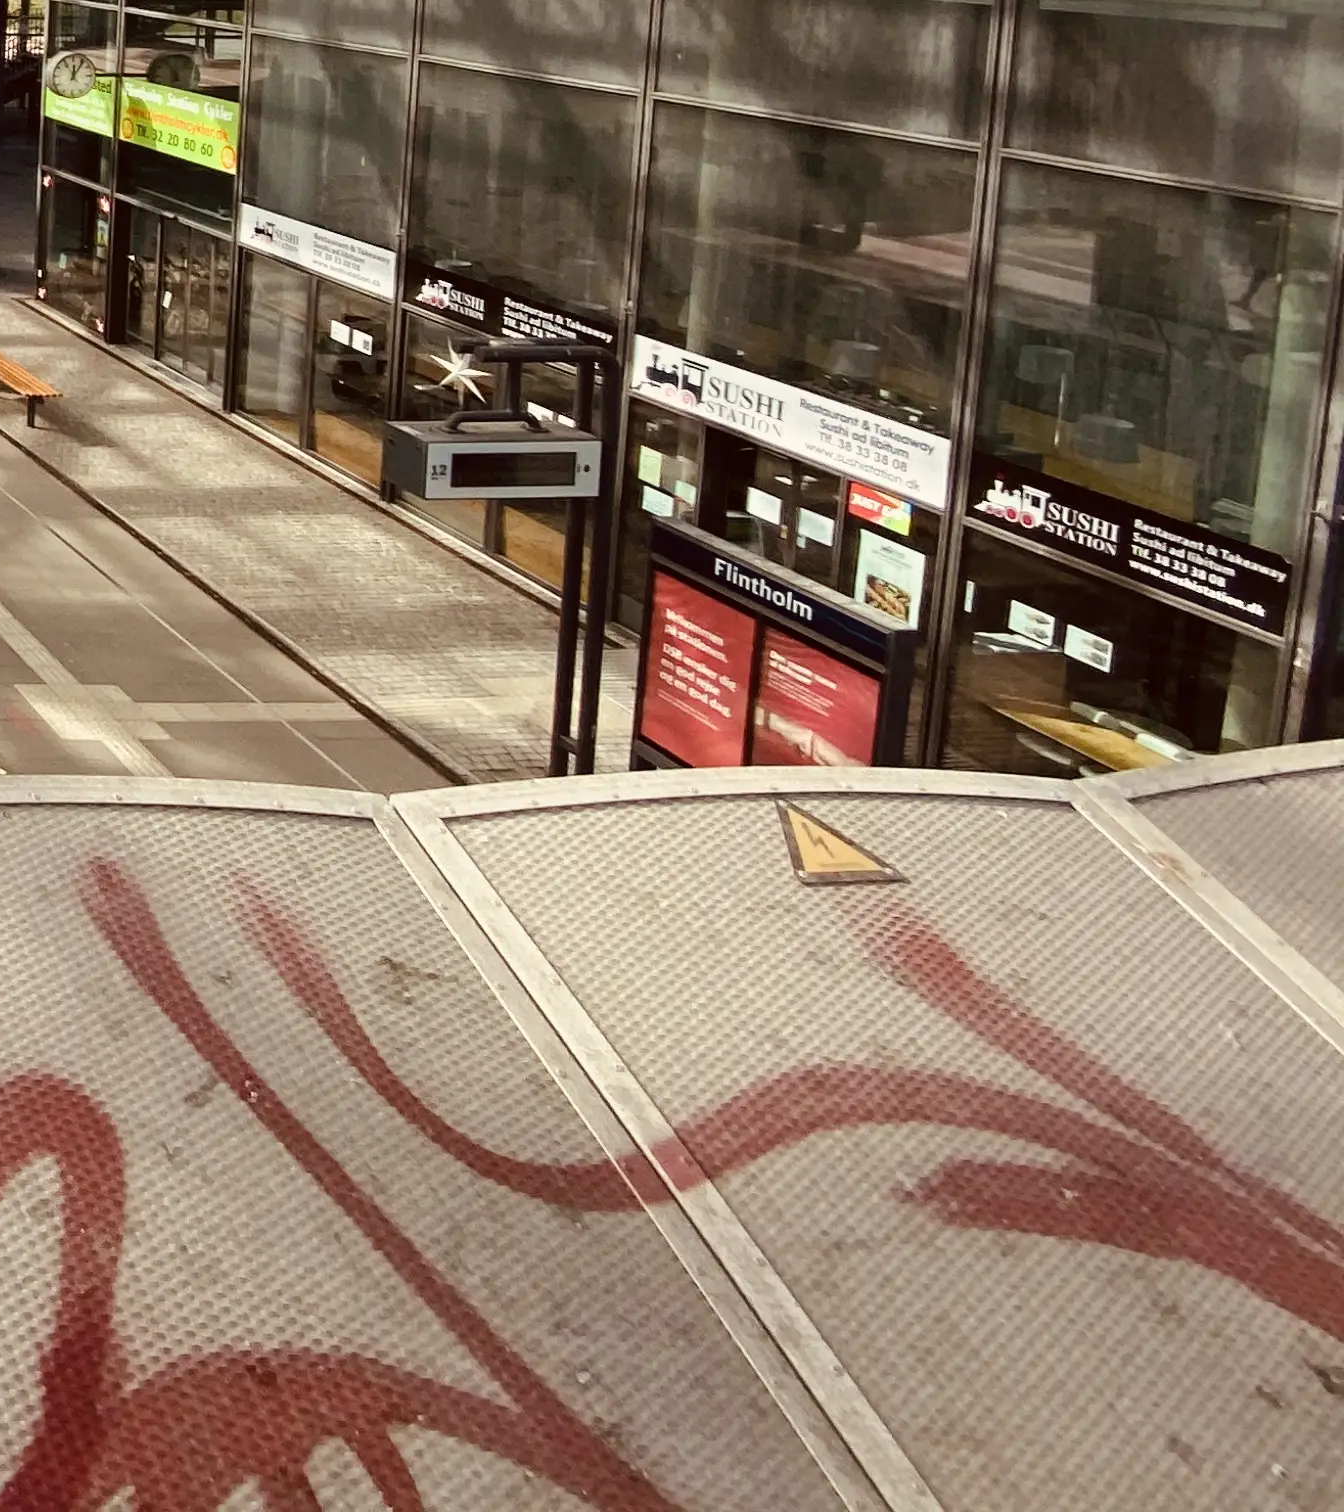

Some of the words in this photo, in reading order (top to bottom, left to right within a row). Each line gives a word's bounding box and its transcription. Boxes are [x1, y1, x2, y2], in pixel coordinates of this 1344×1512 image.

[152, 129, 164, 143] 32
[167, 133, 179, 148] 20
[200, 143, 214, 158] 60
[448, 303, 484, 322] STATION
[450, 289, 486, 313] SUSHI
[708, 376, 785, 422] SUSHI
[704, 401, 784, 438] STATION
[800, 398, 859, 426] Restaurant
[861, 420, 870, 431] &
[874, 424, 935, 456] Takeaway
[820, 419, 849, 437] Sushi
[852, 432, 867, 444] ad
[870, 435, 909, 459] libitum
[837, 439, 852, 452] 38
[856, 445, 870, 459] 33
[874, 452, 889, 466] 38
[892, 459, 907, 473] 08
[430, 464, 448, 476] 12
[1043, 521, 1118, 556] STATION
[1047, 502, 1120, 543] SUSHI
[1132, 532, 1167, 552] Sushi
[1168, 547, 1186, 559] ad
[1134, 518, 1205, 552] Restaurant
[1206, 544, 1219, 557] &
[1220, 548, 1288, 583] Takeaway
[713, 557, 813, 621] Flintholm
